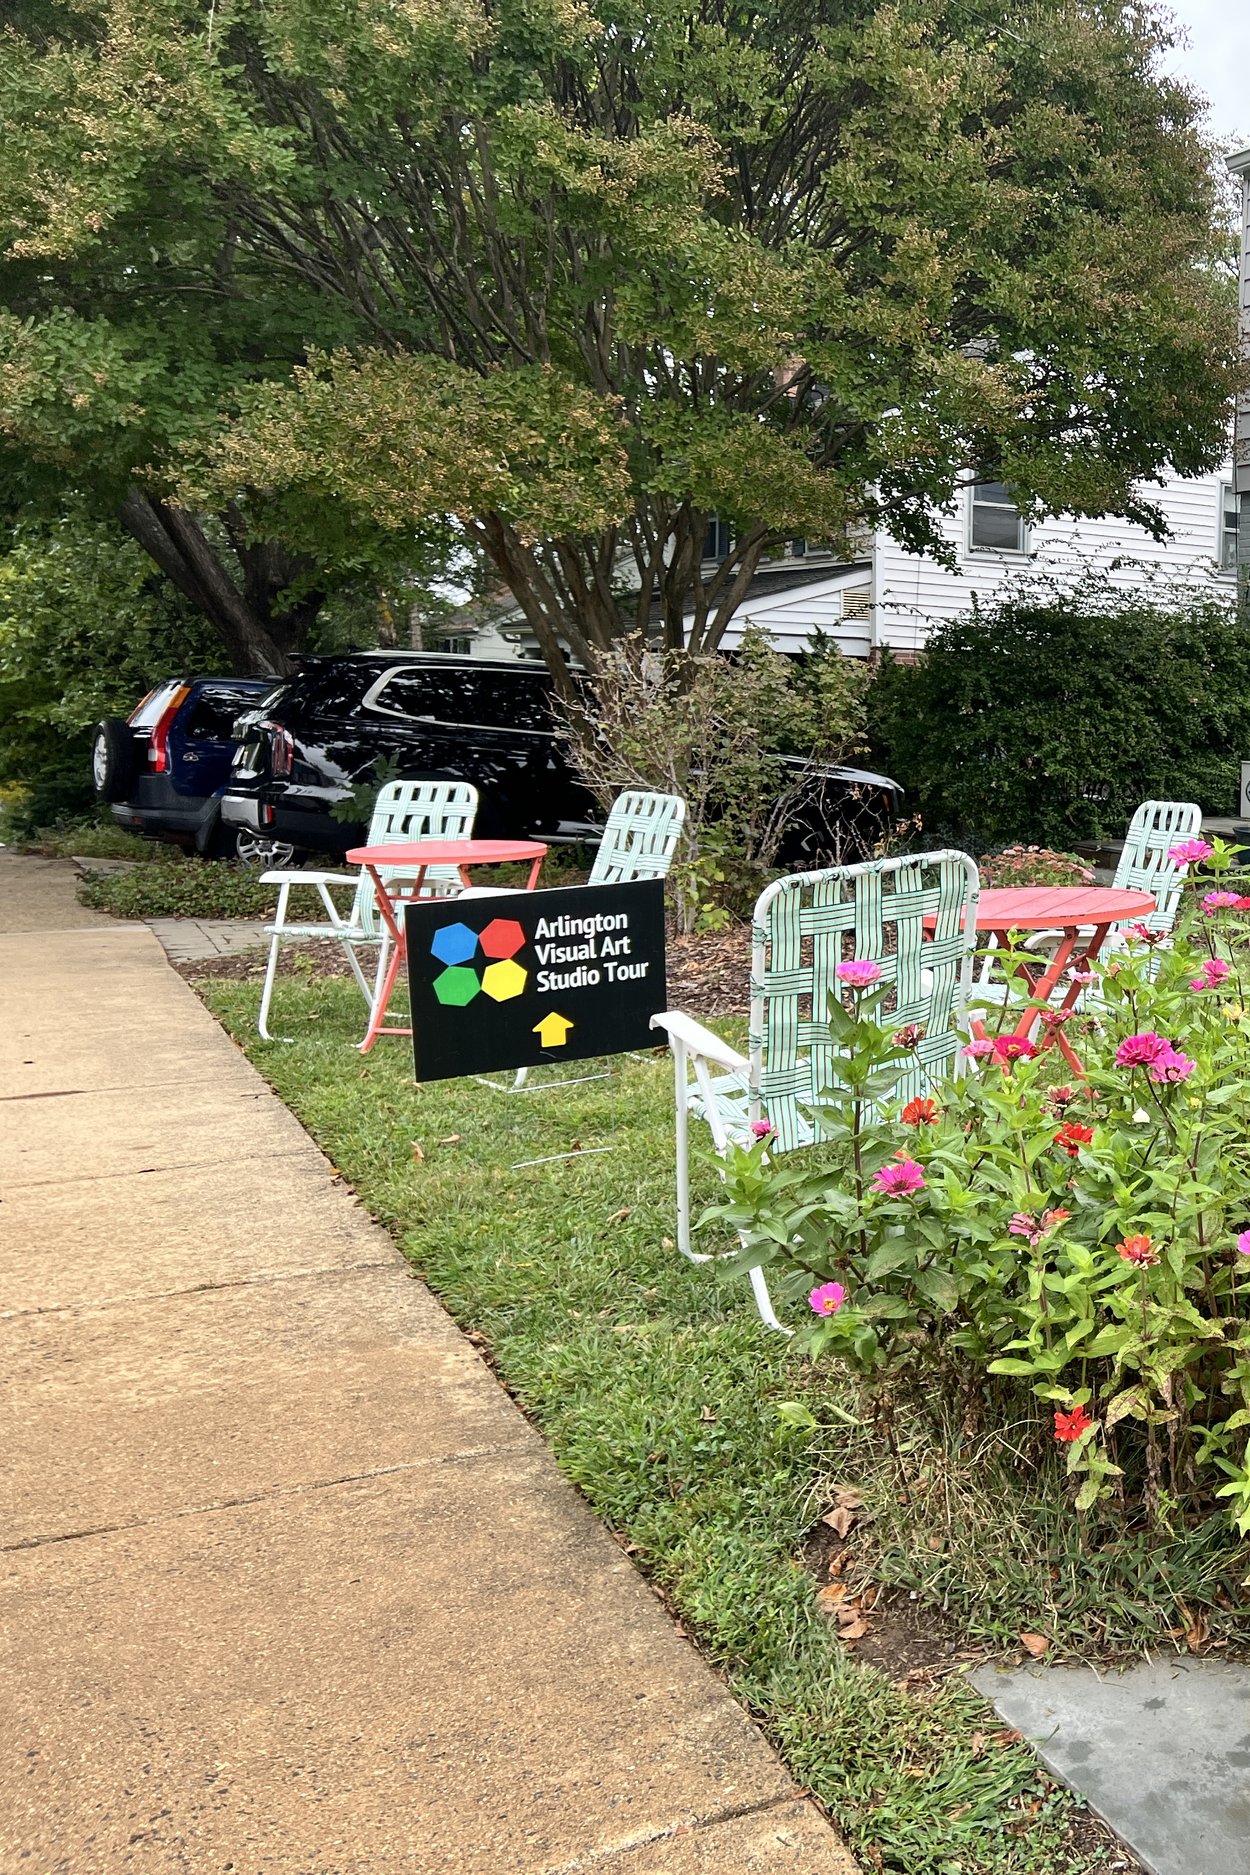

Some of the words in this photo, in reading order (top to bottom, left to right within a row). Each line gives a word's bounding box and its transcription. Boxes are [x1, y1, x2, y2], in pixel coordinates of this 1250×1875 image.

[534, 913, 628, 940] Arlington
[534, 938, 598, 966] Visual
[600, 935, 632, 958] Art
[536, 965, 601, 993] Studio
[602, 960, 650, 983] Tour
